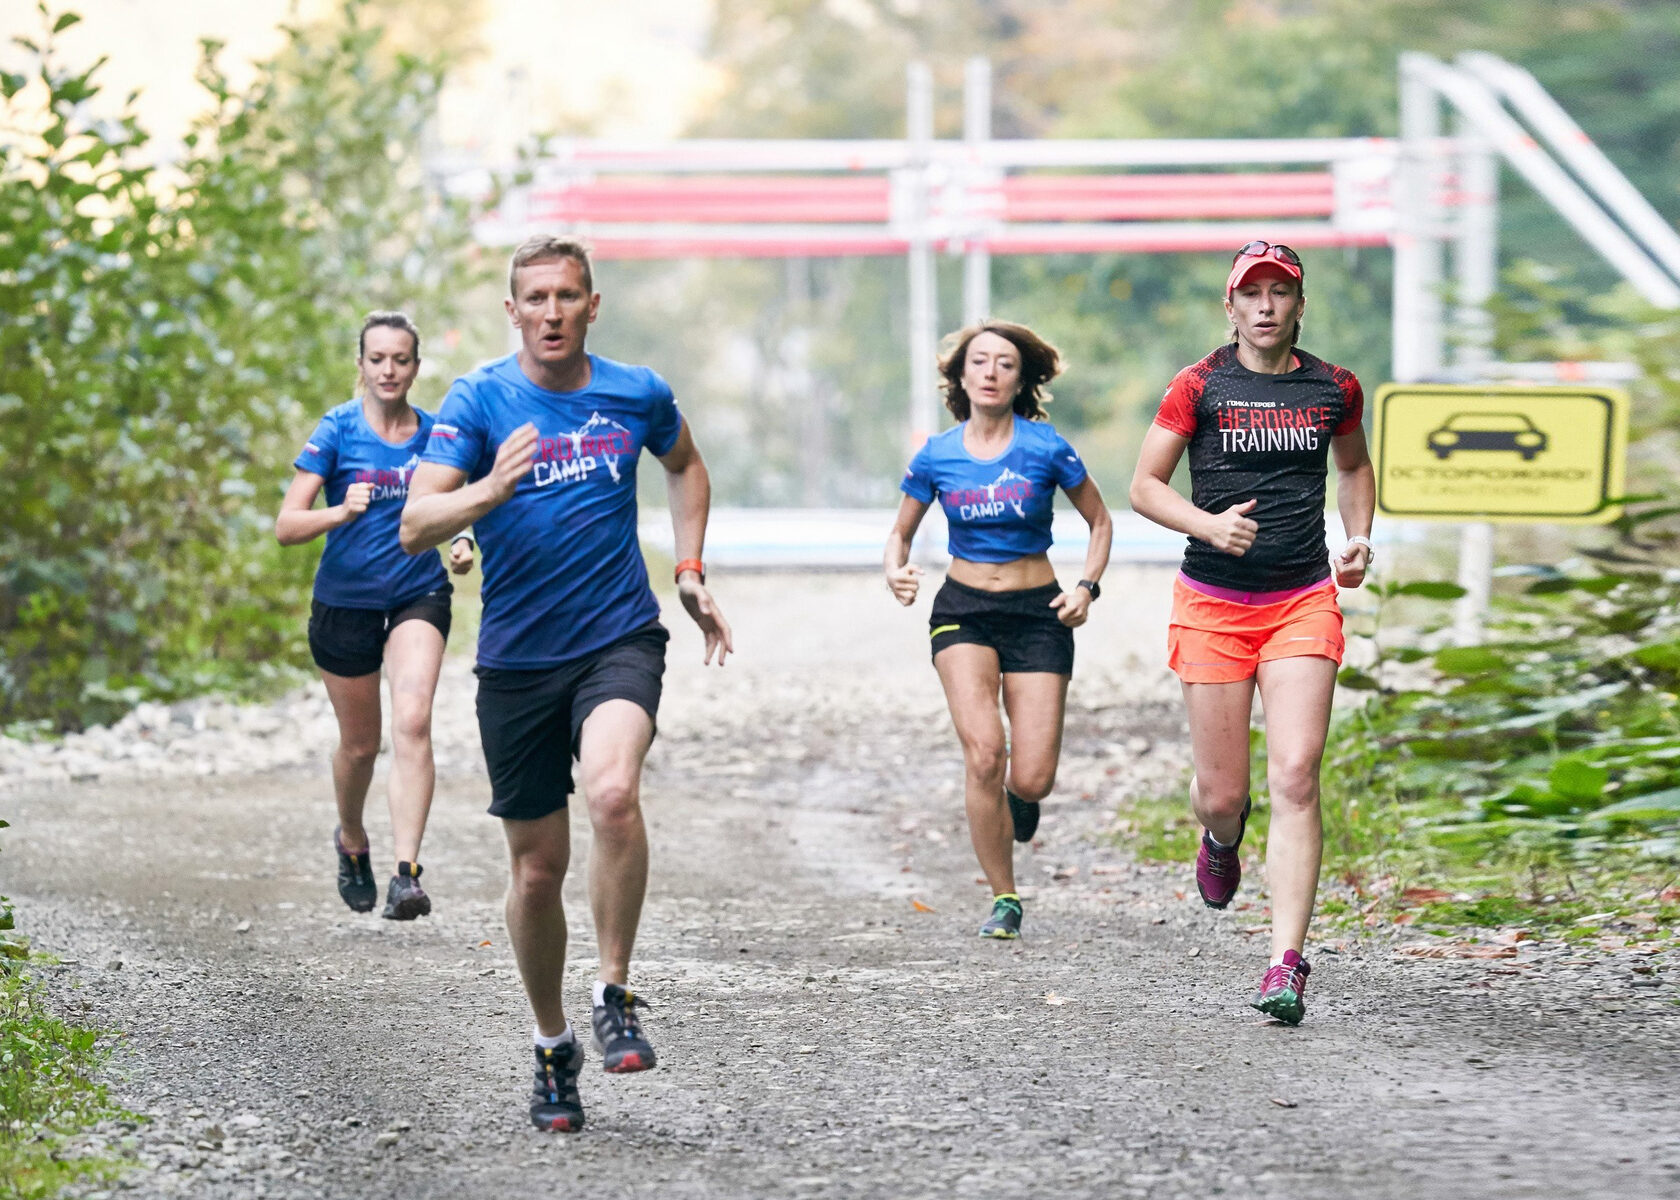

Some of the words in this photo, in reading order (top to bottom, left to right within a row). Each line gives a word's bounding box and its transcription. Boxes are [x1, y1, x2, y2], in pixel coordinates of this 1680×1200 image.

[581, 432, 635, 457] RACE
[1219, 427, 1319, 452] TRAINING
[355, 470, 400, 486] HERO
[533, 456, 597, 487] CAMP
[946, 488, 988, 506] HERO
[994, 482, 1034, 501] RACE
[960, 501, 1005, 521] CAMP
